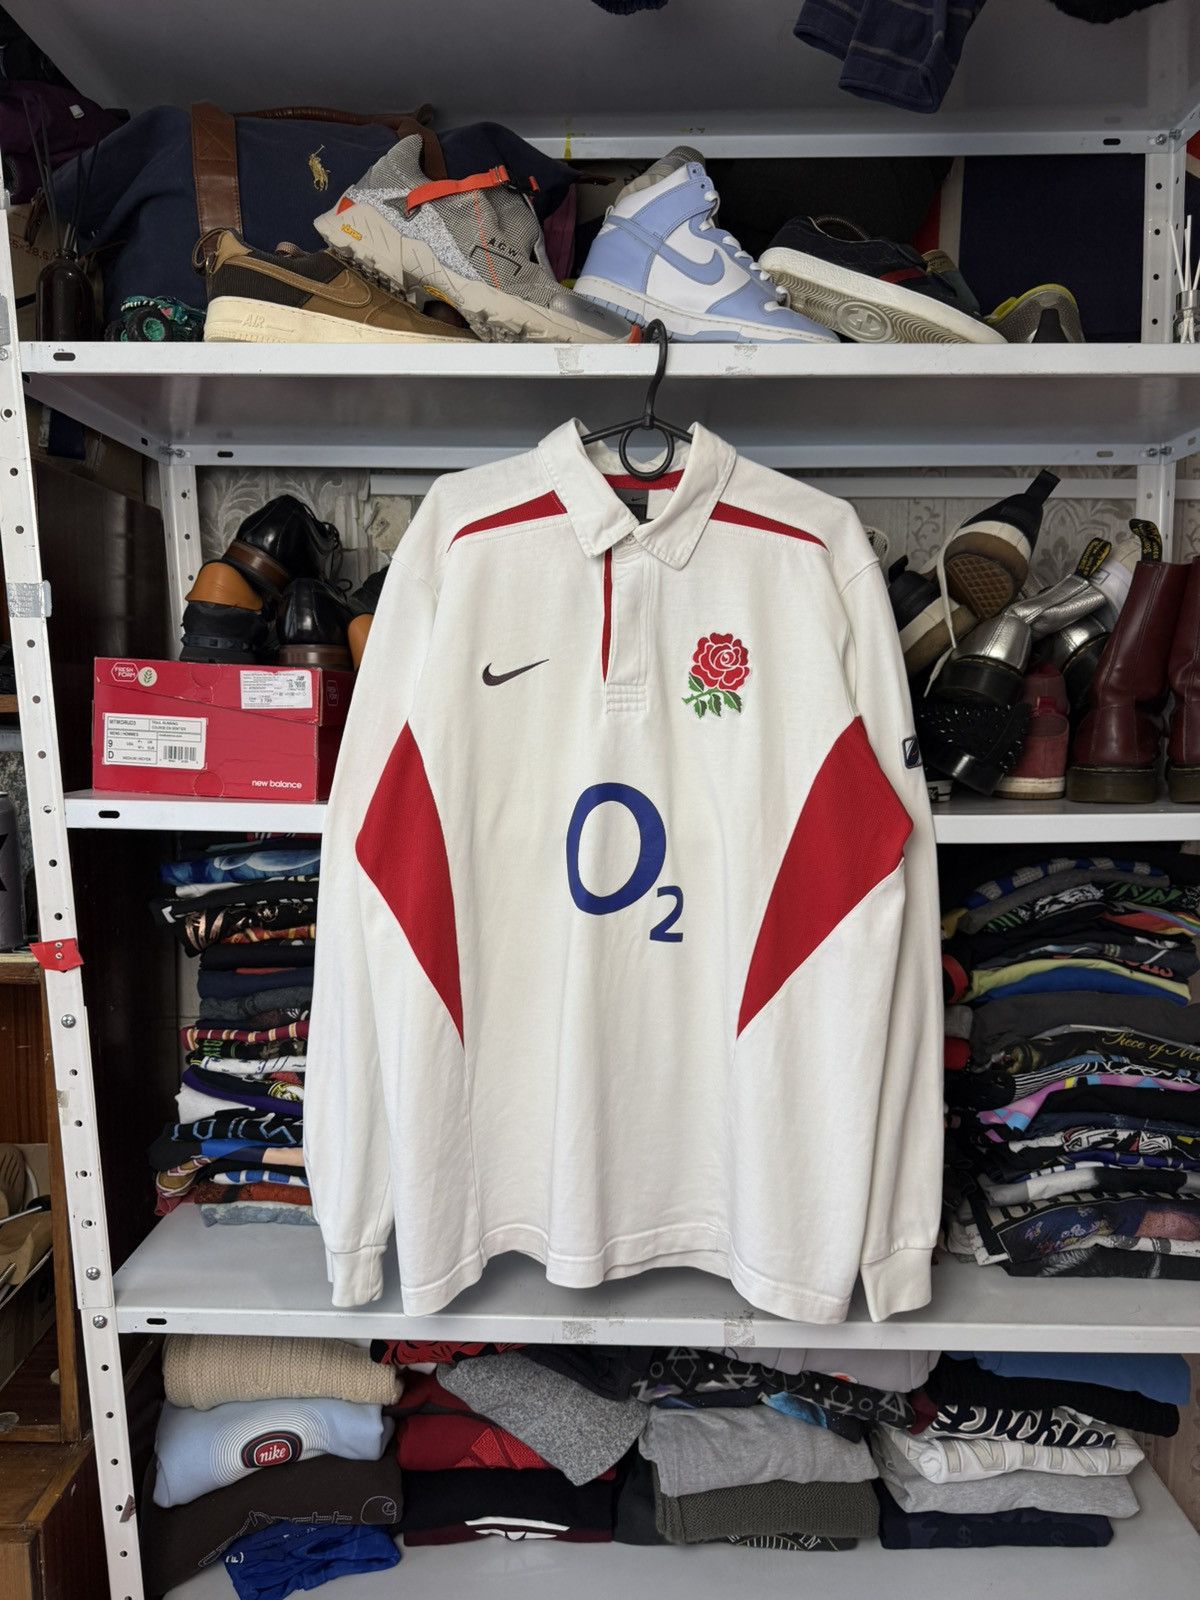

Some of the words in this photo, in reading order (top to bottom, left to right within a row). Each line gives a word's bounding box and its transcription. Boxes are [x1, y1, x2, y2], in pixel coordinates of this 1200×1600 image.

[108, 739, 113, 748] 9
[108, 750, 114, 759] D
[269, 779, 303, 789] balance
[259, 1444, 287, 1462] nike
